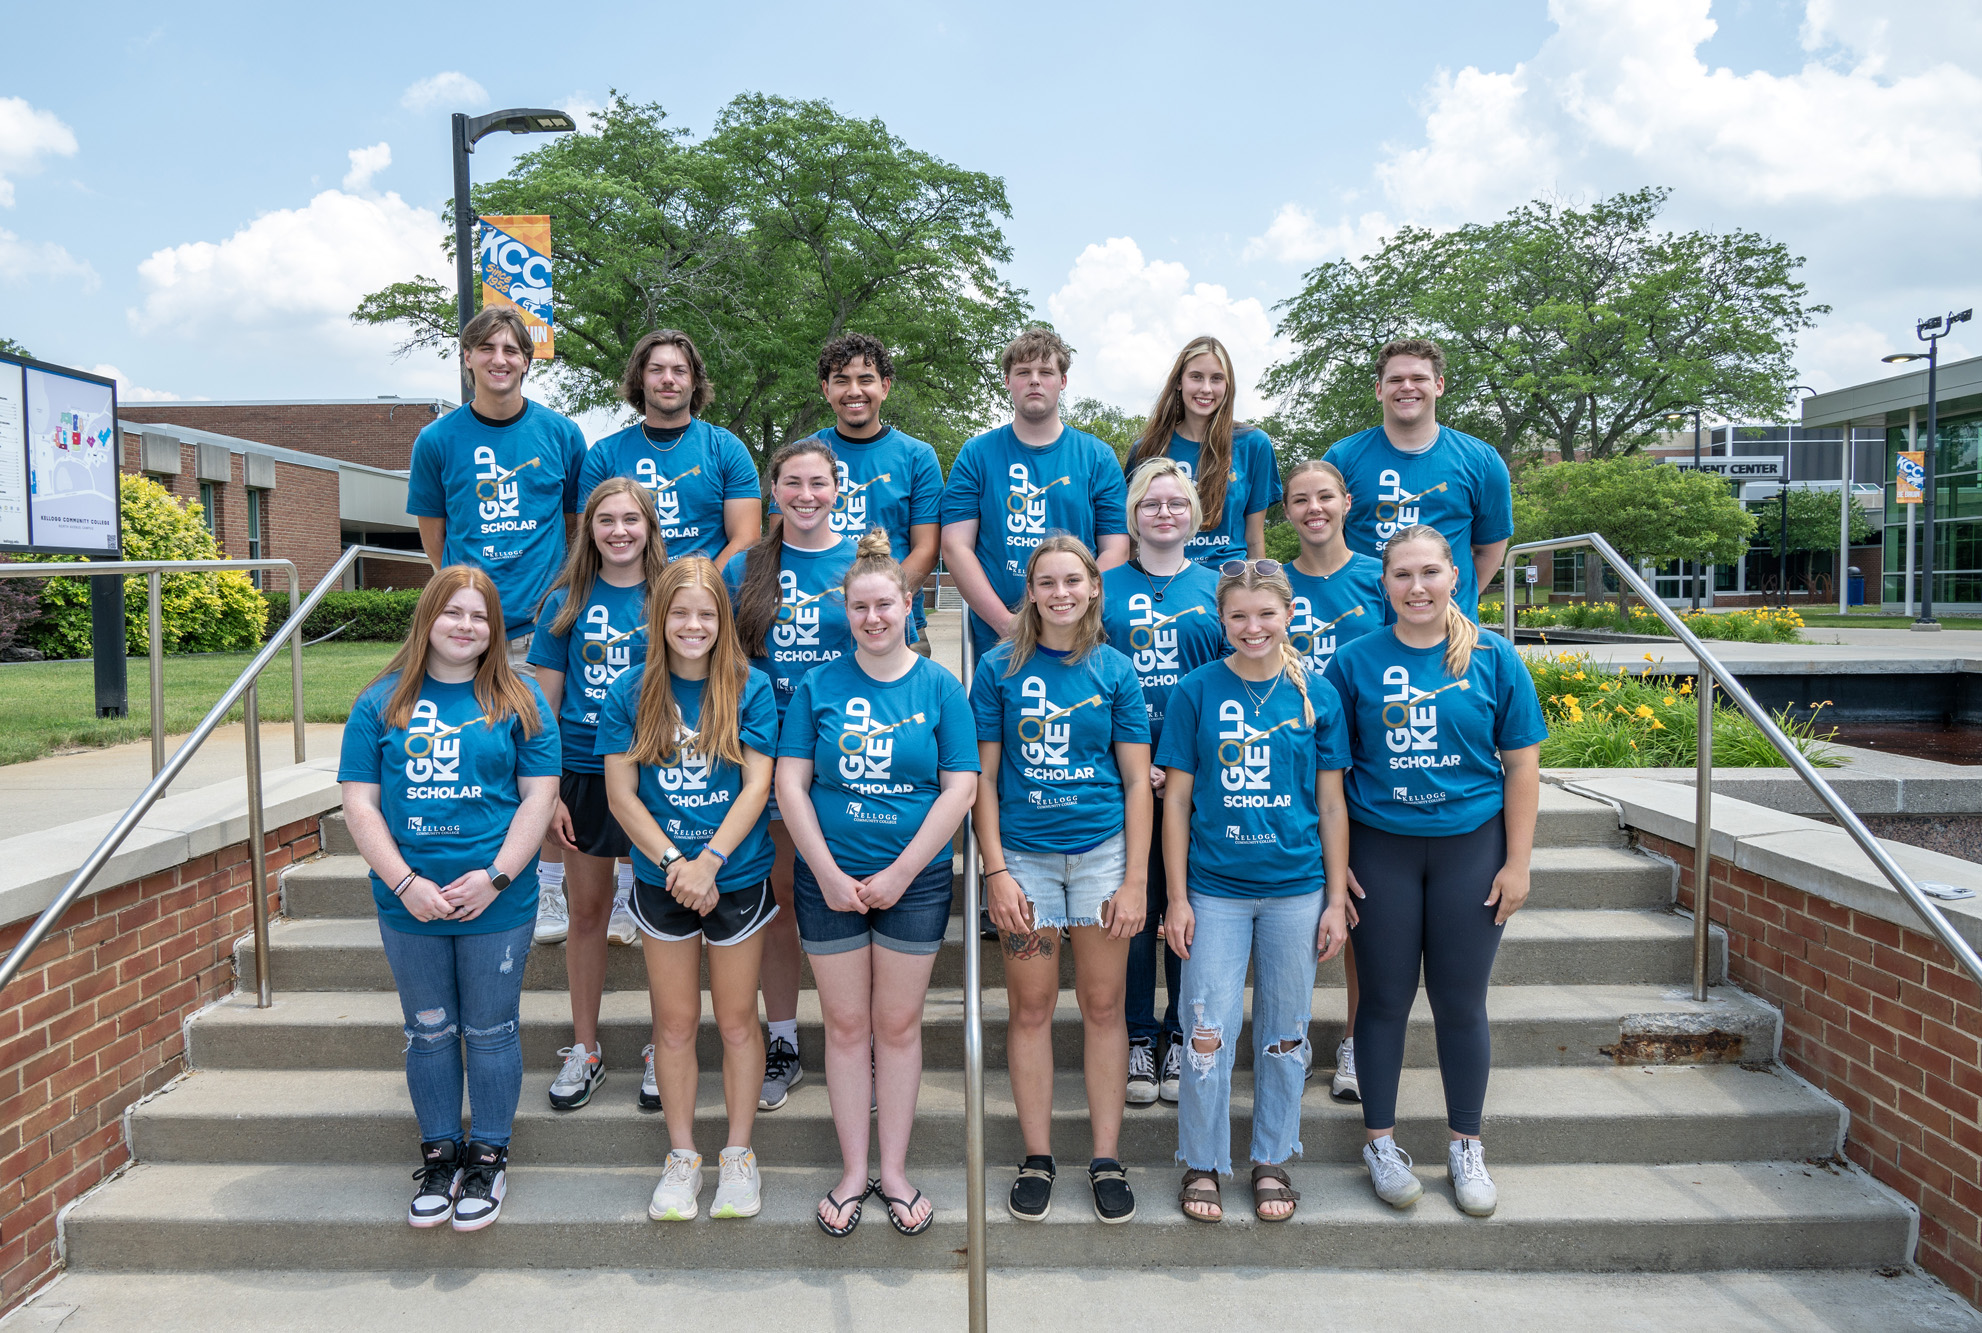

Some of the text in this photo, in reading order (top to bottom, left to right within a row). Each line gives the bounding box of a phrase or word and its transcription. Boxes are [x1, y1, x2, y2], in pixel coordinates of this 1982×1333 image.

[481, 229, 552, 287] KCC
[486, 275, 510, 293] 1956
[474, 445, 500, 520] GOLD
[496, 464, 520, 518] KEY
[1730, 464, 1777, 474] CENTER
[1896, 455, 1924, 478] KCC
[656, 474, 680, 526] KEY
[847, 479, 866, 531] KEY
[1007, 463, 1029, 533] GOLD
[1026, 482, 1046, 534] KEY
[1375, 469, 1400, 539] GOLD
[481, 520, 537, 534] SCHOLAR
[772, 569, 797, 647] GOLD
[796, 589, 820, 645] KEY
[1128, 593, 1156, 673] GOLD
[582, 604, 609, 685] GOLD
[1152, 610, 1180, 670] KEY
[1018, 675, 1047, 765] GOLD
[1044, 700, 1071, 765] KEY
[1382, 665, 1412, 753] GOLD
[1409, 685, 1438, 751] KEY
[404, 699, 438, 783] GOLD
[433, 719, 461, 781] KEY
[838, 697, 871, 780] GOLD
[865, 718, 894, 780] KEY
[1218, 699, 1246, 792] GOLD
[1244, 723, 1271, 790] KEY
[1389, 754, 1461, 770] SCHOLAR
[406, 785, 482, 799] SCHOLAR
[665, 790, 730, 808] CHOLAR
[1023, 767, 1095, 781] SCHOLAR
[1036, 794, 1078, 806] KELLOGG
[1223, 794, 1291, 808] SCHOLAR
[1402, 791, 1446, 802] KELLOGG
[854, 812, 898, 821] KELLOGG
[1234, 833, 1277, 841] KELLOGG
